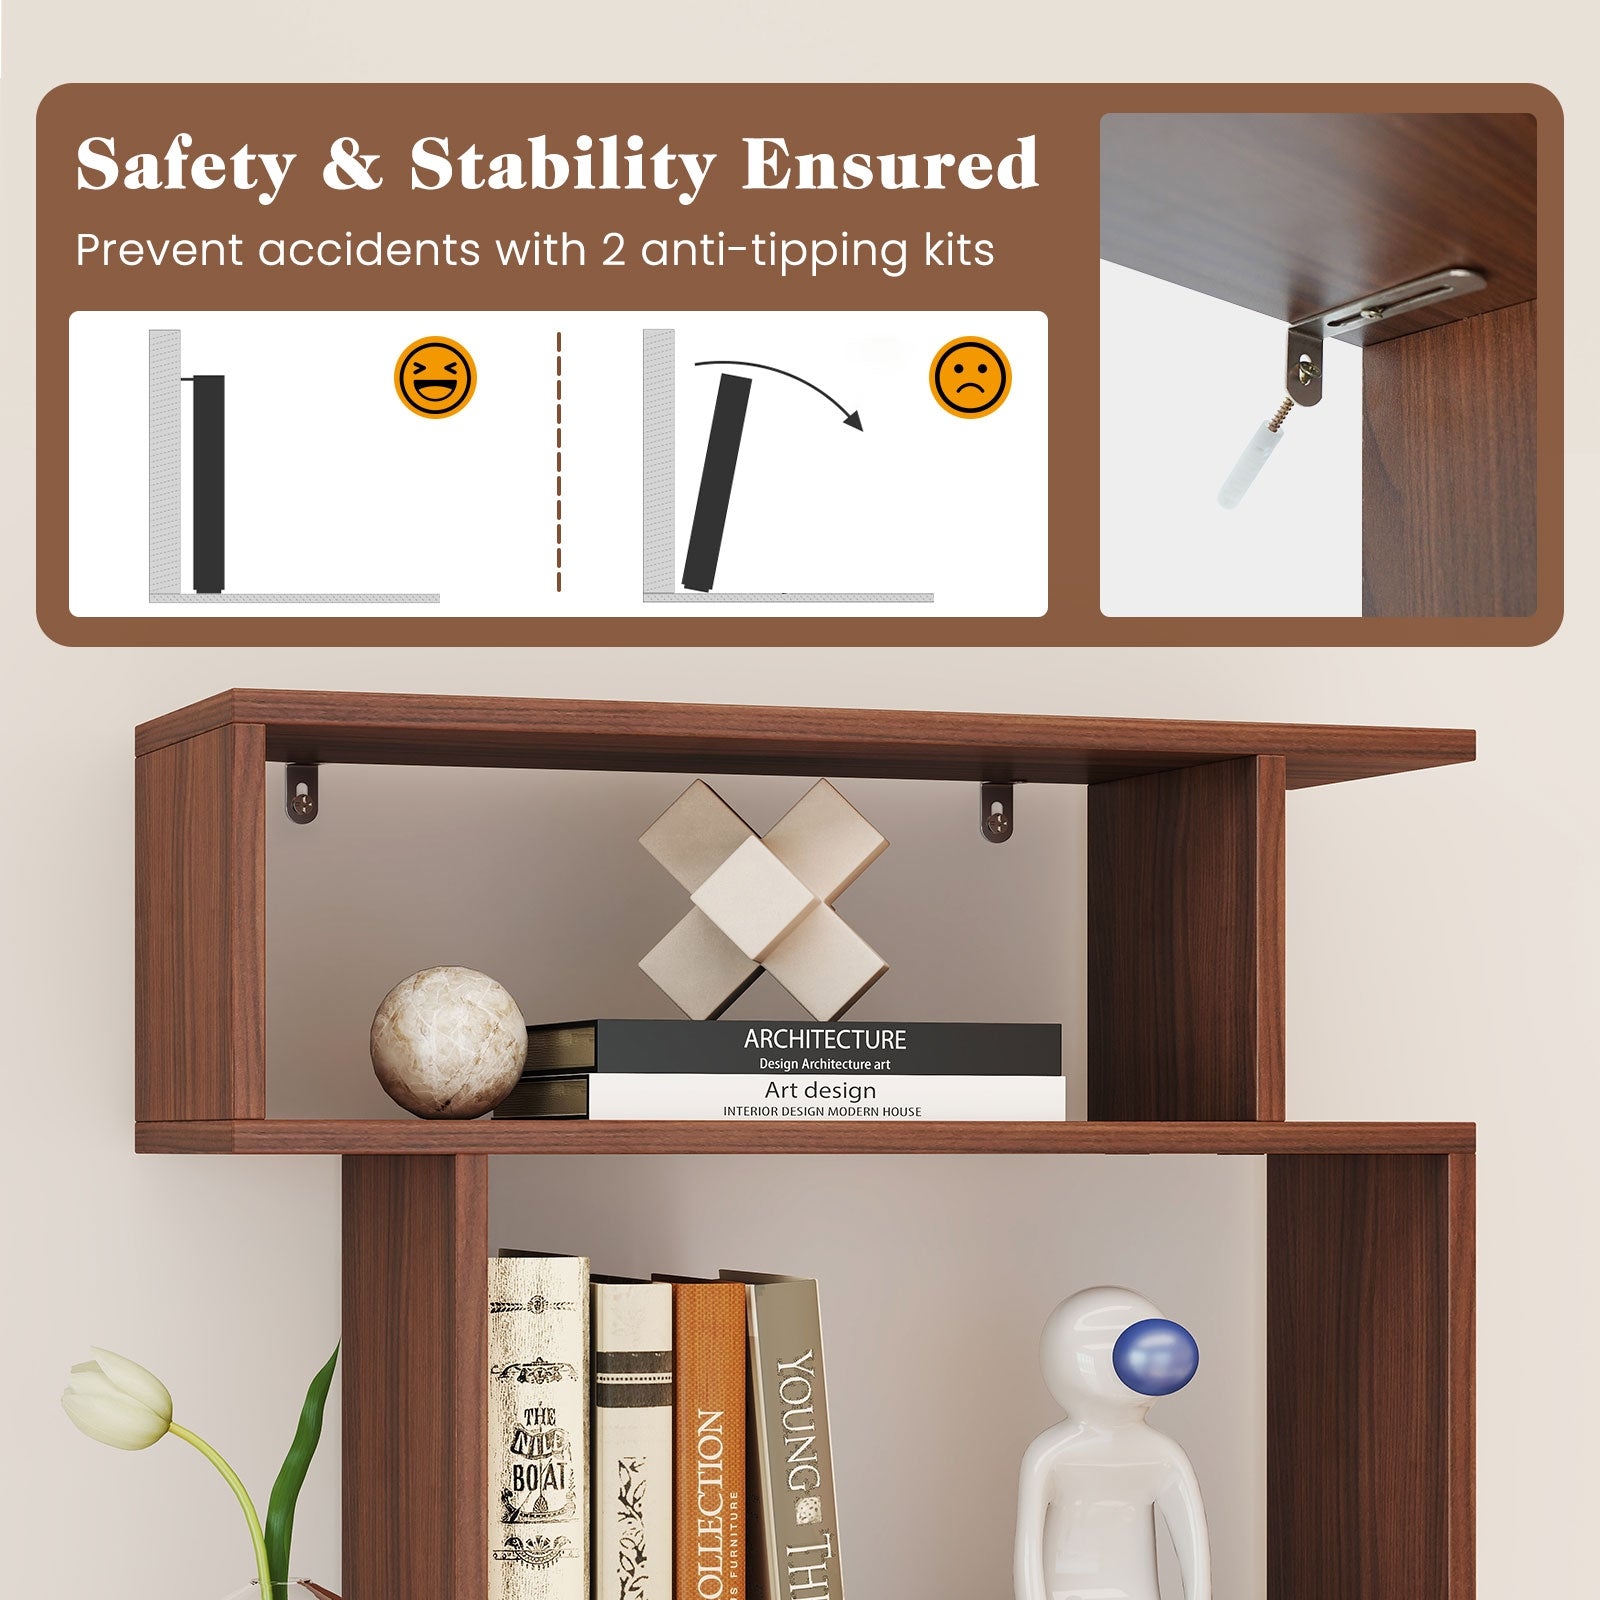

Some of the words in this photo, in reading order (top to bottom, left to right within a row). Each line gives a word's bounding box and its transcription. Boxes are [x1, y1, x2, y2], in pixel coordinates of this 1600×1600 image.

[743, 1028, 907, 1050] ARCHITECTURE
[759, 1057, 799, 1073] Design
[801, 1057, 871, 1071] Architecture
[873, 1059, 891, 1071] art
[764, 1081, 798, 1099] Art
[804, 1080, 876, 1104] design
[723, 1106, 779, 1117] INTERIOR
[781, 1106, 826, 1117] DESIGN
[828, 1106, 879, 1117] MODERN
[882, 1106, 922, 1117] HOUSE
[523, 1407, 556, 1426] THE
[777, 1348, 821, 1492] YOUNG
[513, 1462, 568, 1491] BOAT
[697, 1409, 725, 1600] OLLECTION
[729, 1491, 739, 1578] FURNITURE
[786, 1533, 833, 1600] TH
